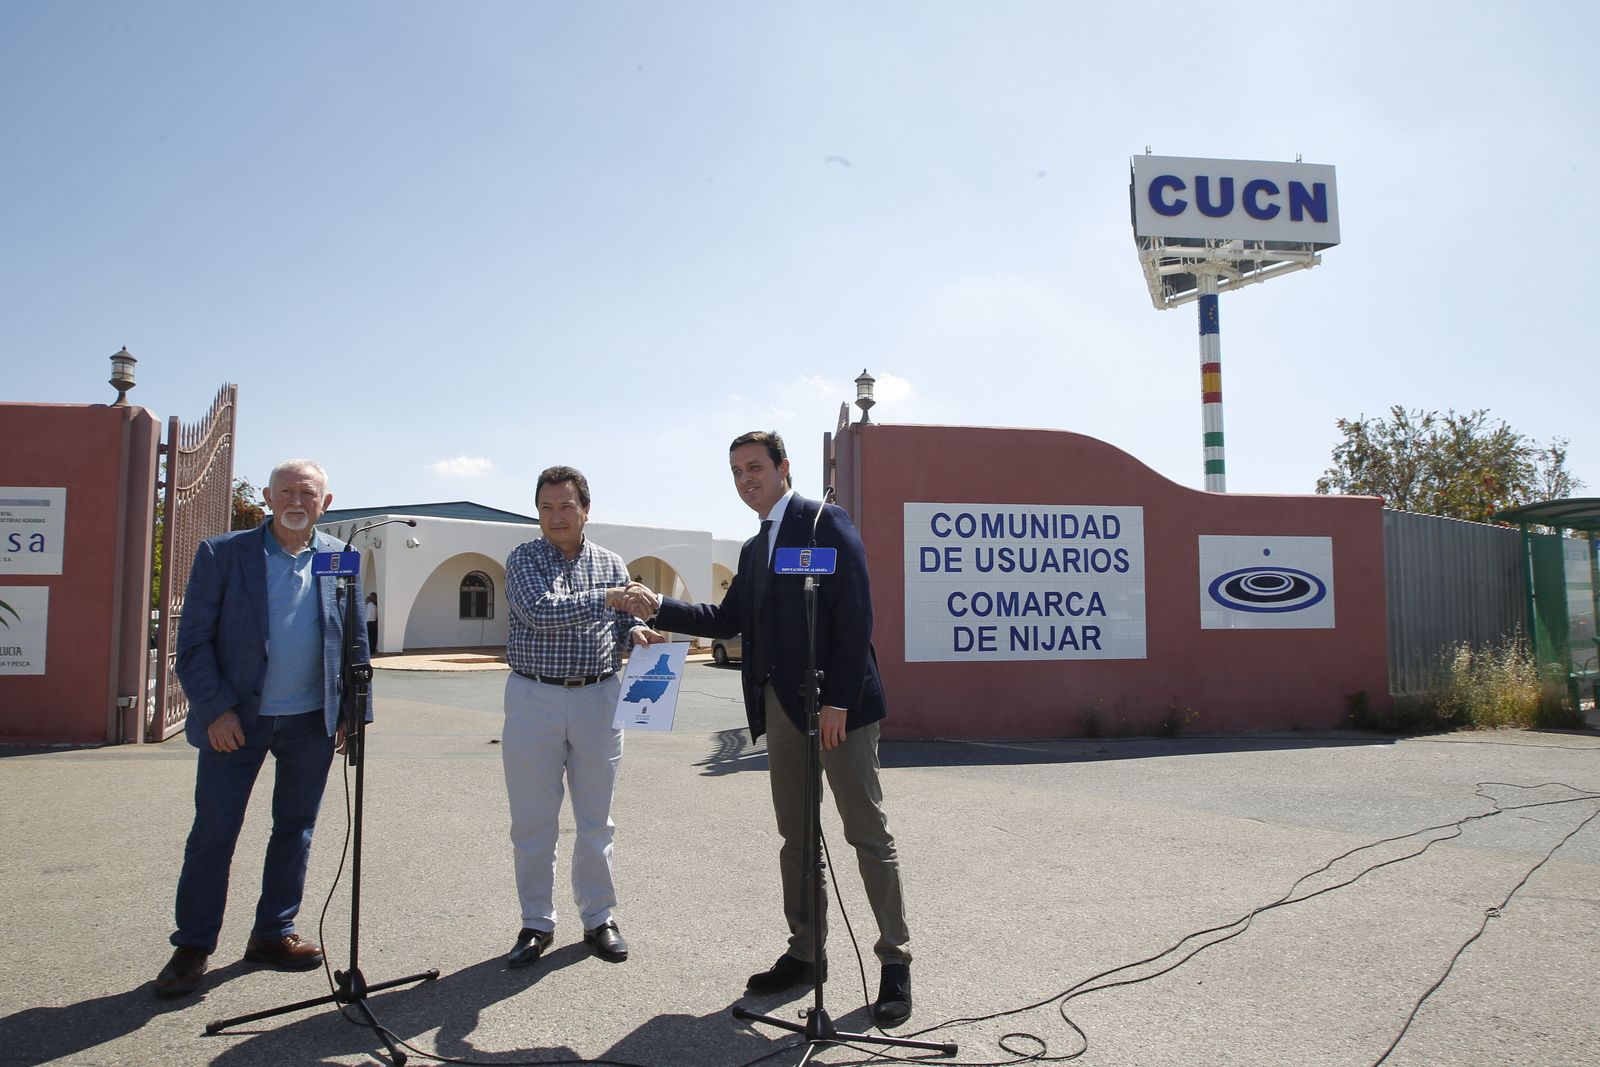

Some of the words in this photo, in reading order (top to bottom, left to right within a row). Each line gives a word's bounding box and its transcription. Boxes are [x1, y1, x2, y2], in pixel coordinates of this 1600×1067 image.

[1148, 175, 1328, 224] CUCN
[930, 512, 1121, 540] COMUNIDAD
[919, 546, 963, 573] DE
[975, 547, 1130, 574] USUARIOS
[947, 591, 1107, 618] COMARCA
[953, 625, 998, 652] DE
[1010, 625, 1102, 652] NIJAR
